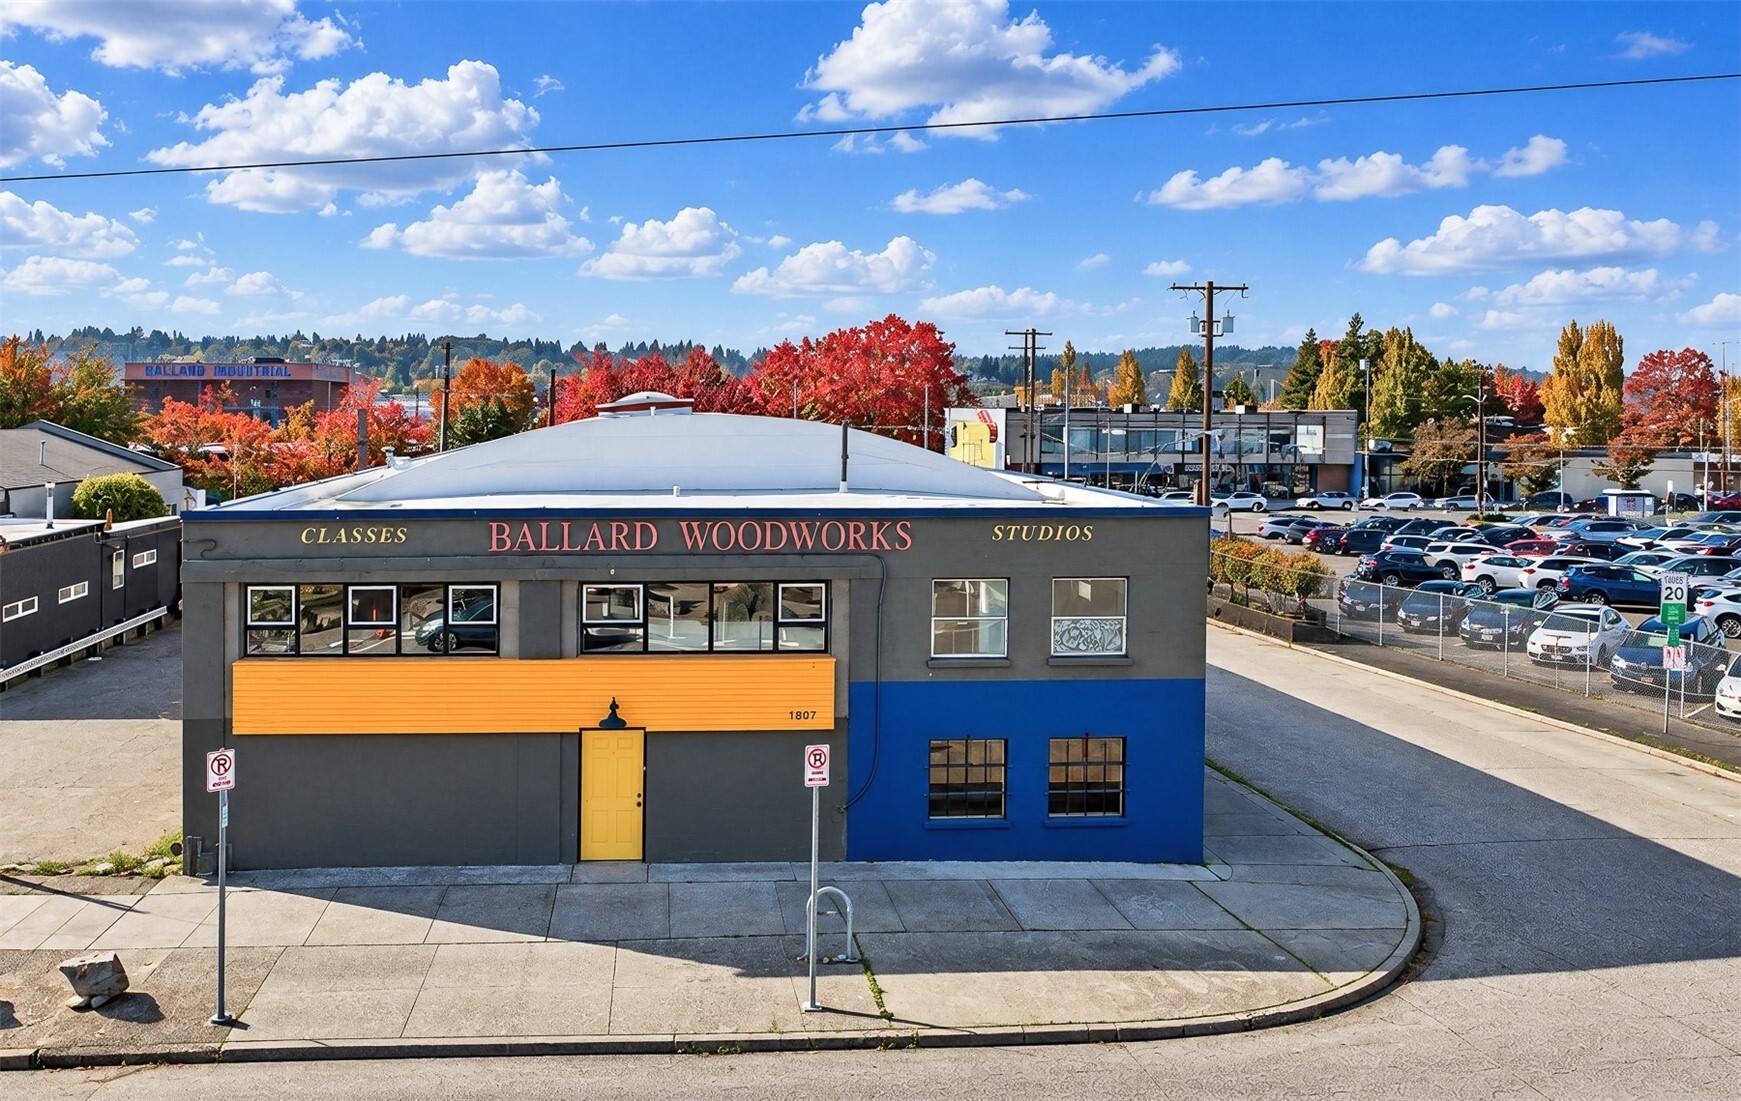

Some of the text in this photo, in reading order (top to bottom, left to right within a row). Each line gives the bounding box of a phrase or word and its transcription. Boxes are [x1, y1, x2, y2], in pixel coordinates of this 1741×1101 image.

[300, 527, 408, 544] CLASSES
[488, 521, 912, 552] BALLARD WOODWORKS
[991, 524, 1094, 542] STUDIOS
[1664, 586, 1684, 600] 20
[789, 710, 817, 720] 1807
